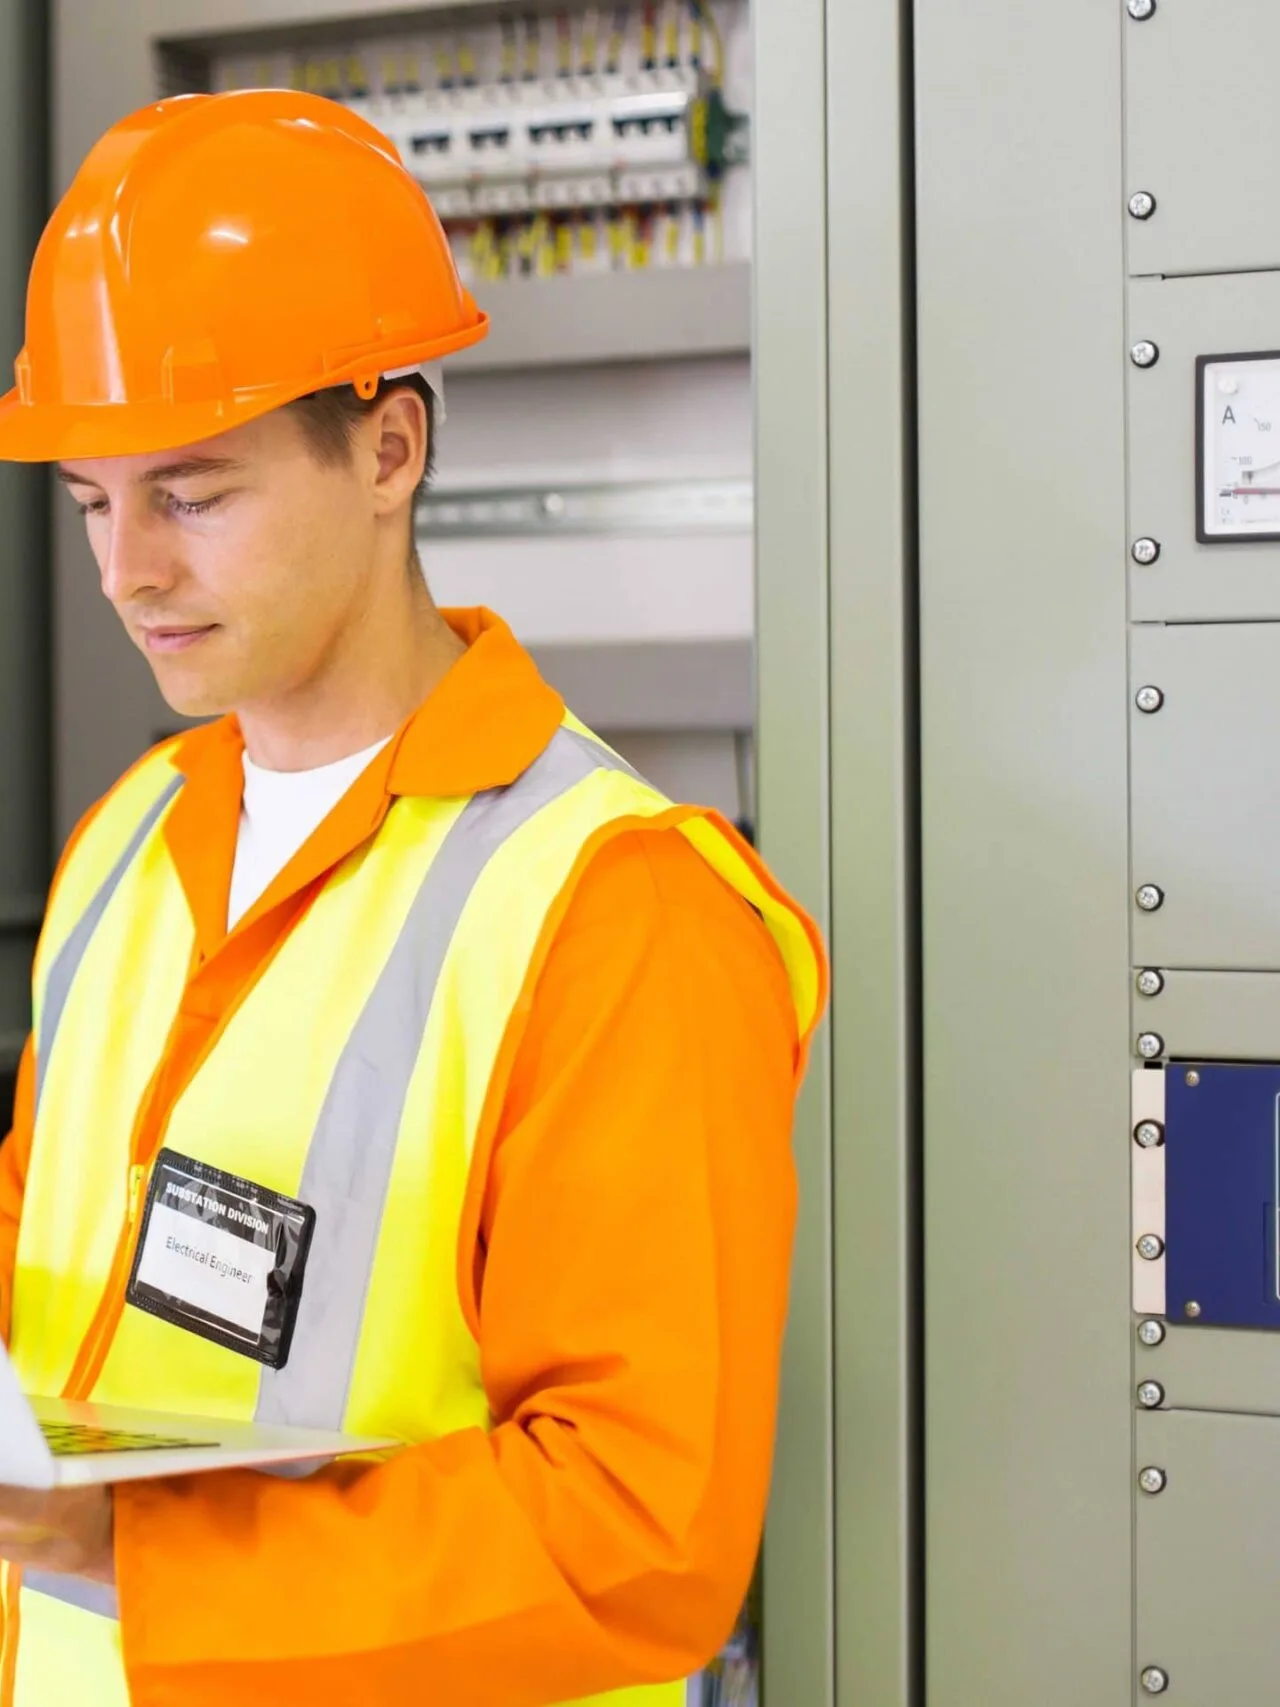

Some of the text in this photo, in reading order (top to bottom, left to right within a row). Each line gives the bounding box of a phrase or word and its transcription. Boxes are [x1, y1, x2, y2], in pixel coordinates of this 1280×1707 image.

[1222, 405, 1236, 425] A
[166, 1182, 269, 1235] SUBSTATION DIVISION
[166, 1236, 253, 1285] Electrical Engineer
